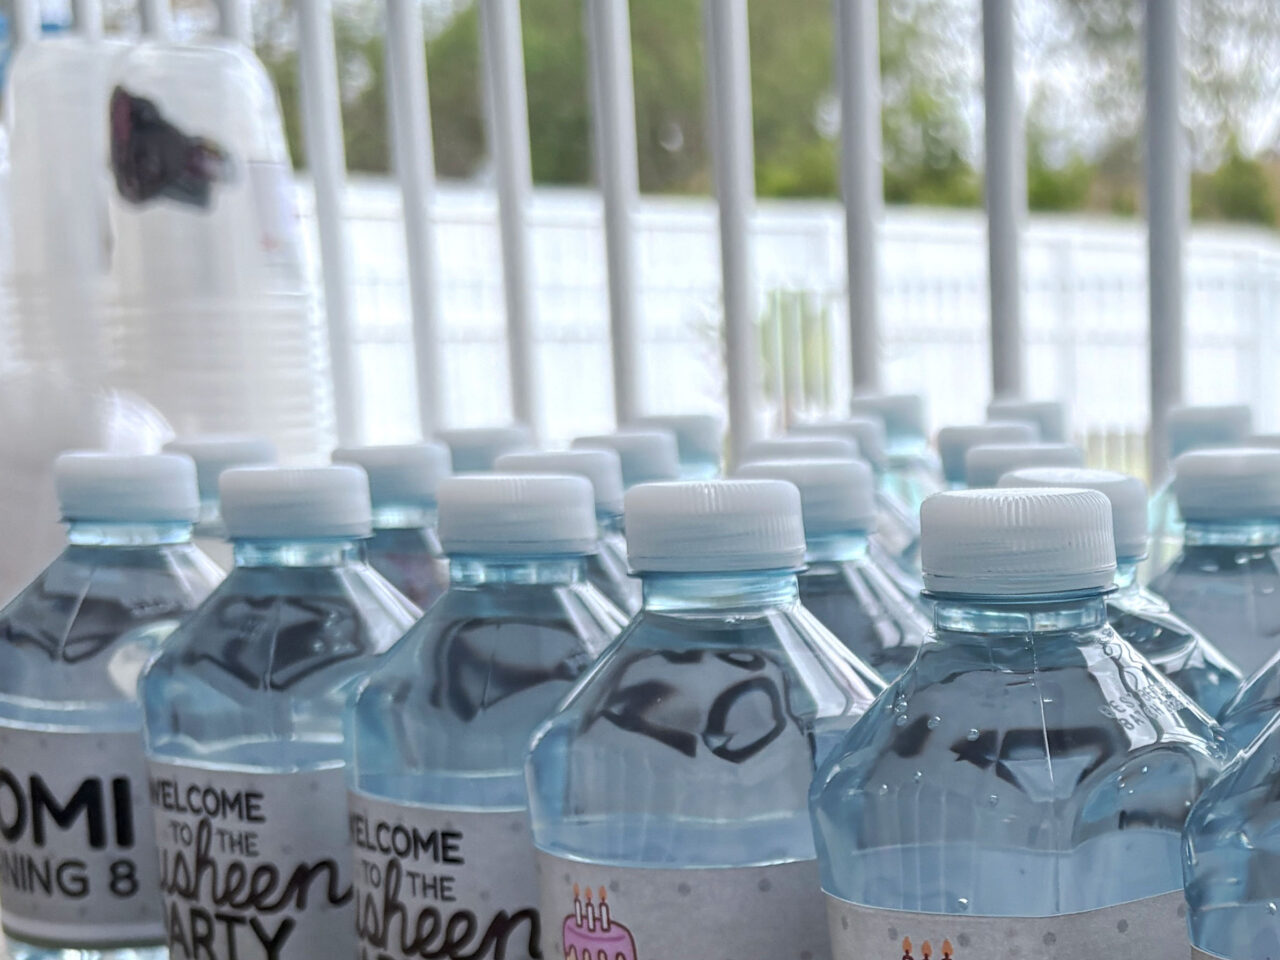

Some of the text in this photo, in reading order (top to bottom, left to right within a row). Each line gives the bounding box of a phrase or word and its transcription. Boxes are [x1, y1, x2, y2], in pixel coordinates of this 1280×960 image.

[170, 820, 259, 857] TO THE
[109, 859, 138, 898] 8
[362, 859, 456, 901] TO THE
